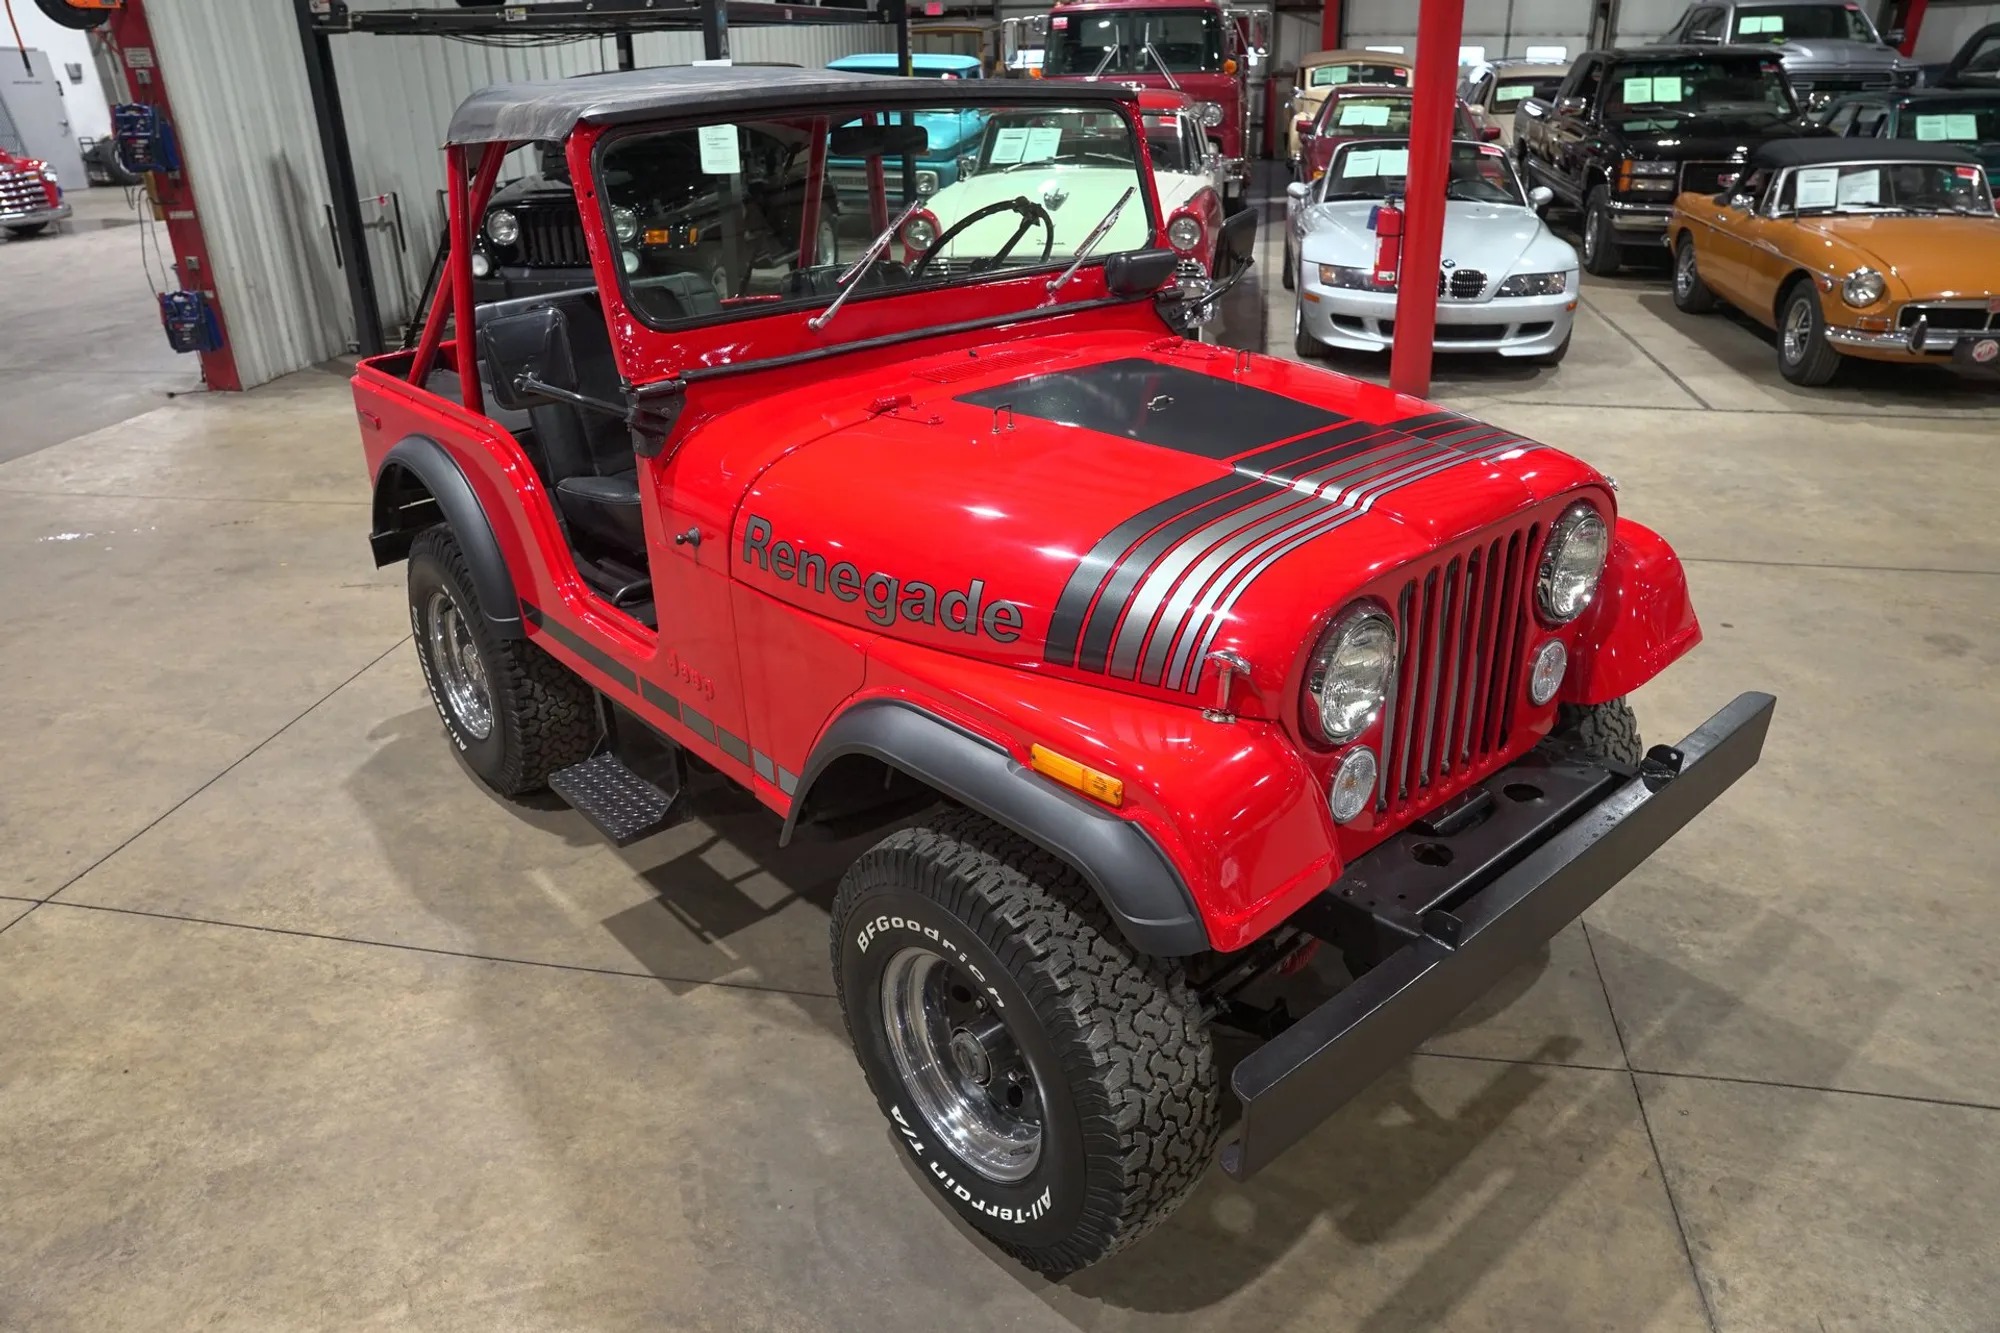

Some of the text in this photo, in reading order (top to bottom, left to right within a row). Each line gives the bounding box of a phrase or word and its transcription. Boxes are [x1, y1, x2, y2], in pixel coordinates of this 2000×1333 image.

[742, 514, 1024, 643] Renegade
[666, 647, 715, 702] Jeep
[856, 915, 1005, 1009] BFGoodrich
[890, 1105, 1052, 1224] All-Terrain T/A
